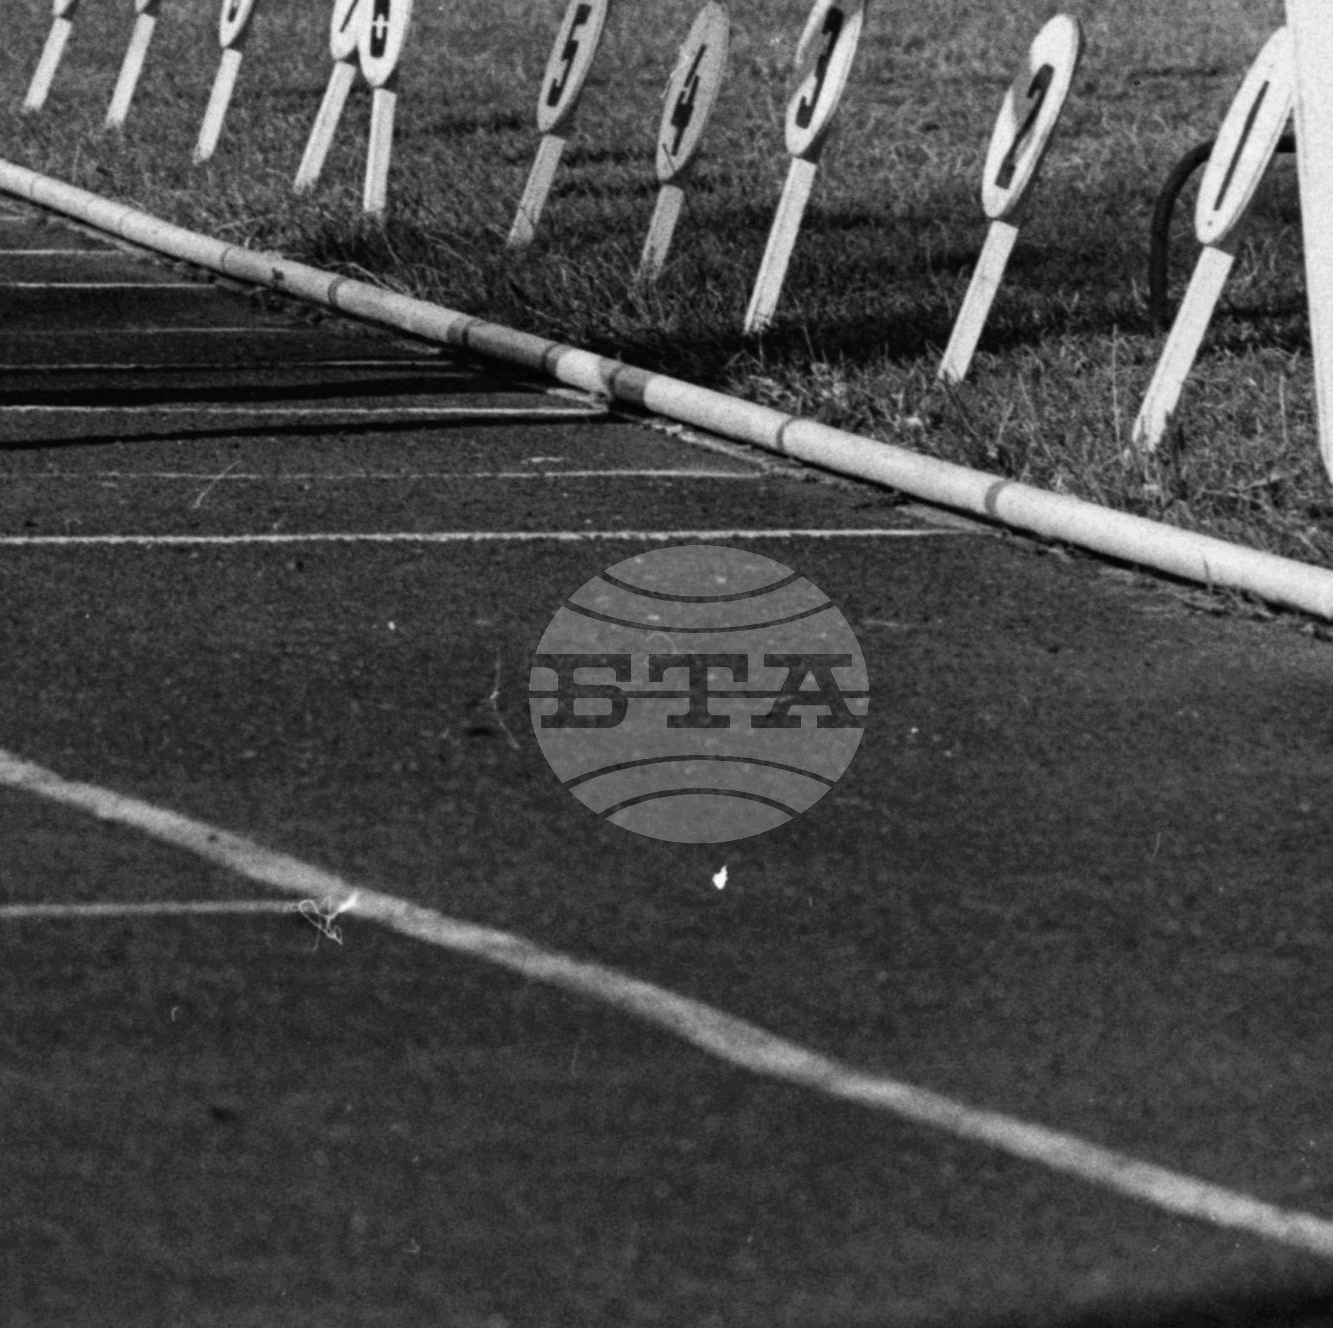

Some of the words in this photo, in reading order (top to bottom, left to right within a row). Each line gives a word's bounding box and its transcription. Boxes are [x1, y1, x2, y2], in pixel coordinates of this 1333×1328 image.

[547, 3, 592, 107] 5
[795, 7, 844, 129] 3
[994, 62, 1054, 190] 2
